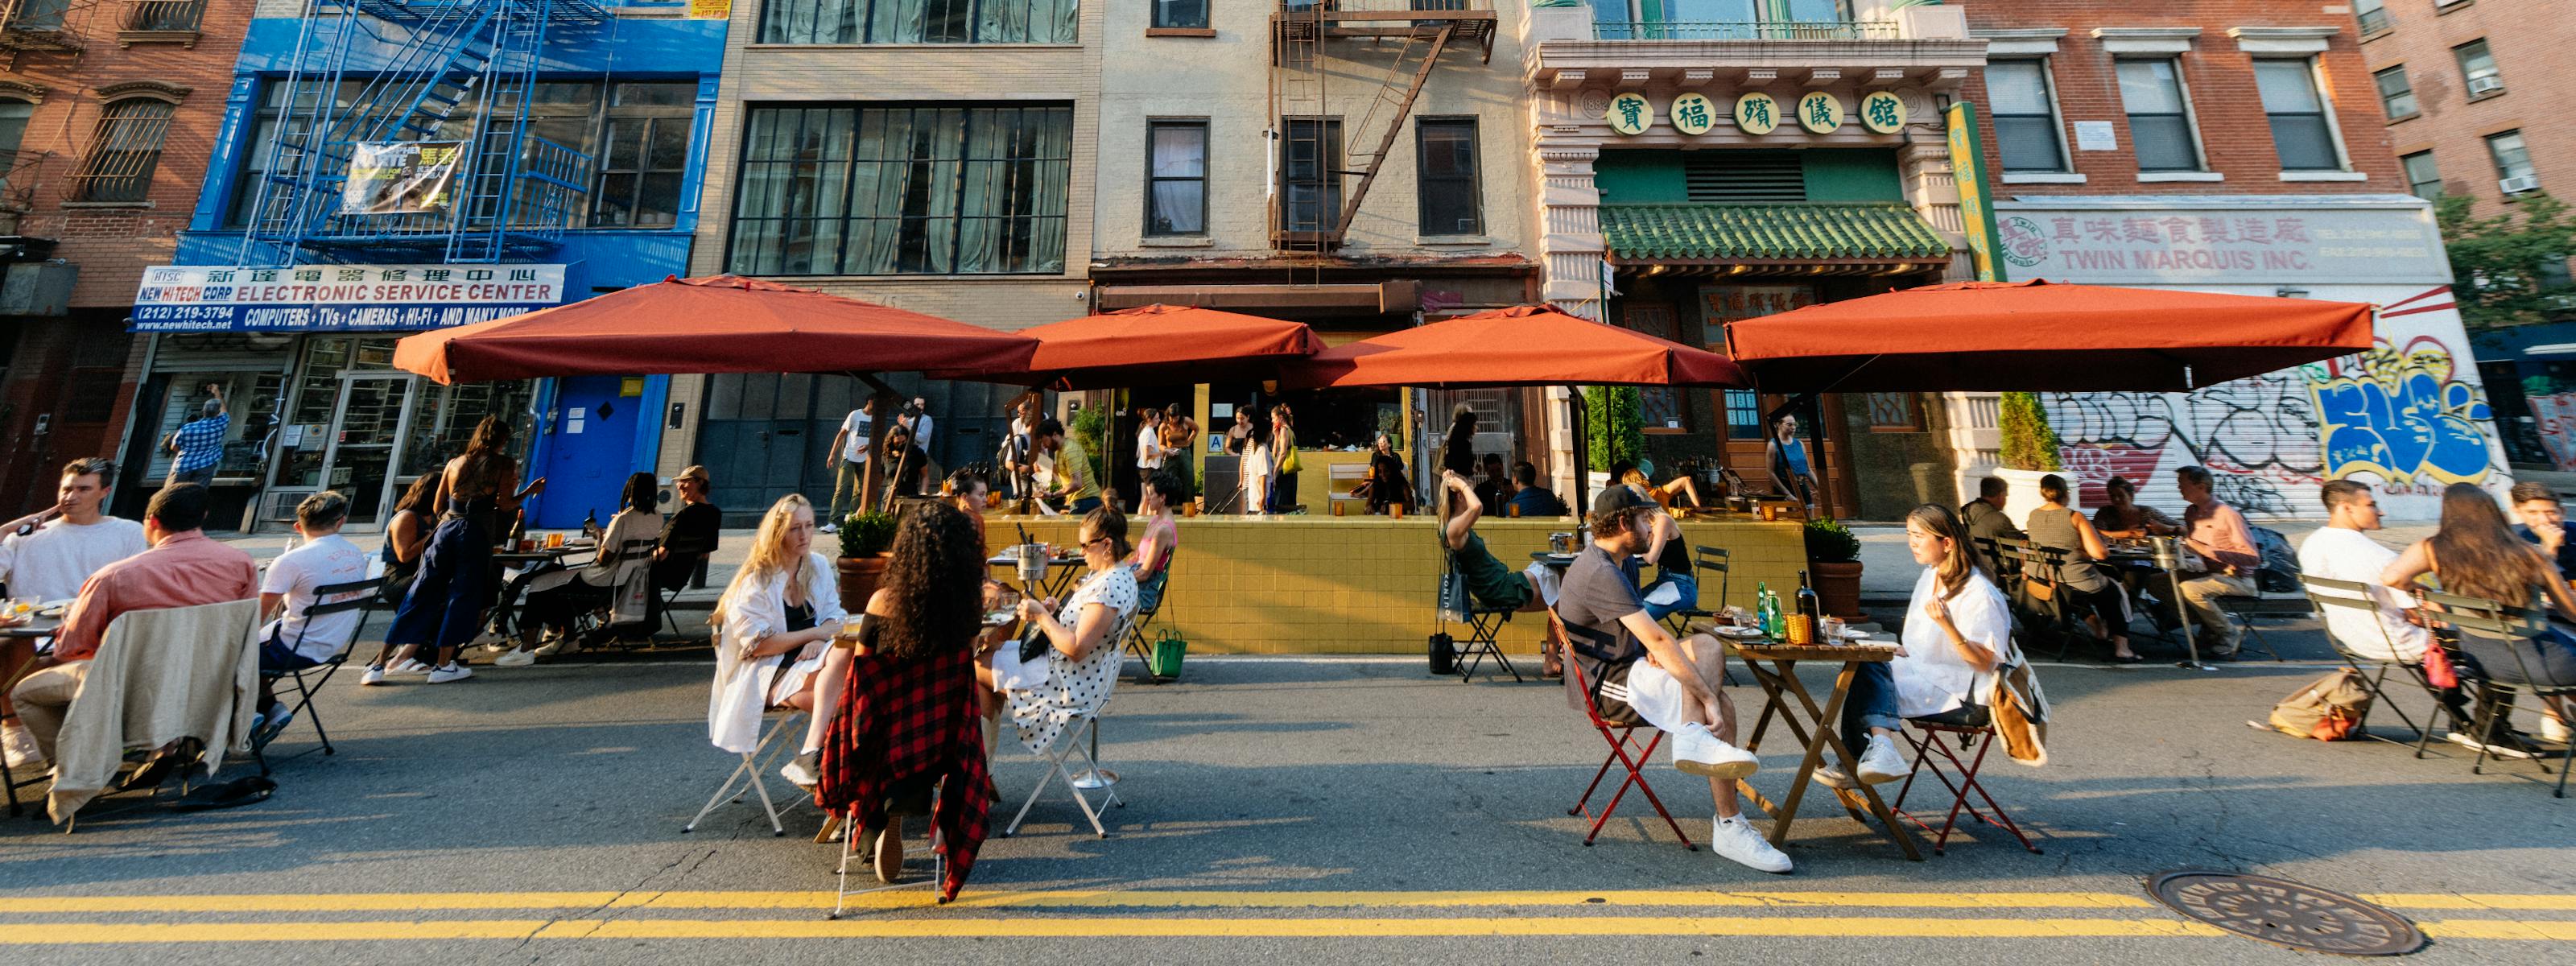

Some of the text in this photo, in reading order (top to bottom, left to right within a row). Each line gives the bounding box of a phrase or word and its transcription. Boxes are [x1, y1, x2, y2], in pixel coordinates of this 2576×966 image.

[1584, 98, 1608, 111] 1882
[2059, 250, 2126, 270] TWIN
[2133, 249, 2255, 270] MARQUIS
[2261, 250, 2315, 270] INC.
[139, 287, 163, 300] NEW
[236, 283, 551, 302] ELECTRONIC SERVICE CENTER
[138, 307, 234, 320] (212) 219-3794
[244, 308, 311, 327] COMPUTERS
[319, 308, 340, 327] TVs
[348, 308, 401, 326] CAMERAS
[406, 307, 433, 326] HI-FI
[440, 307, 464, 325] AND
[464, 307, 500, 325] MANY
[136, 319, 233, 331] www.newhitech.net
[1211, 436, 1221, 448] A
